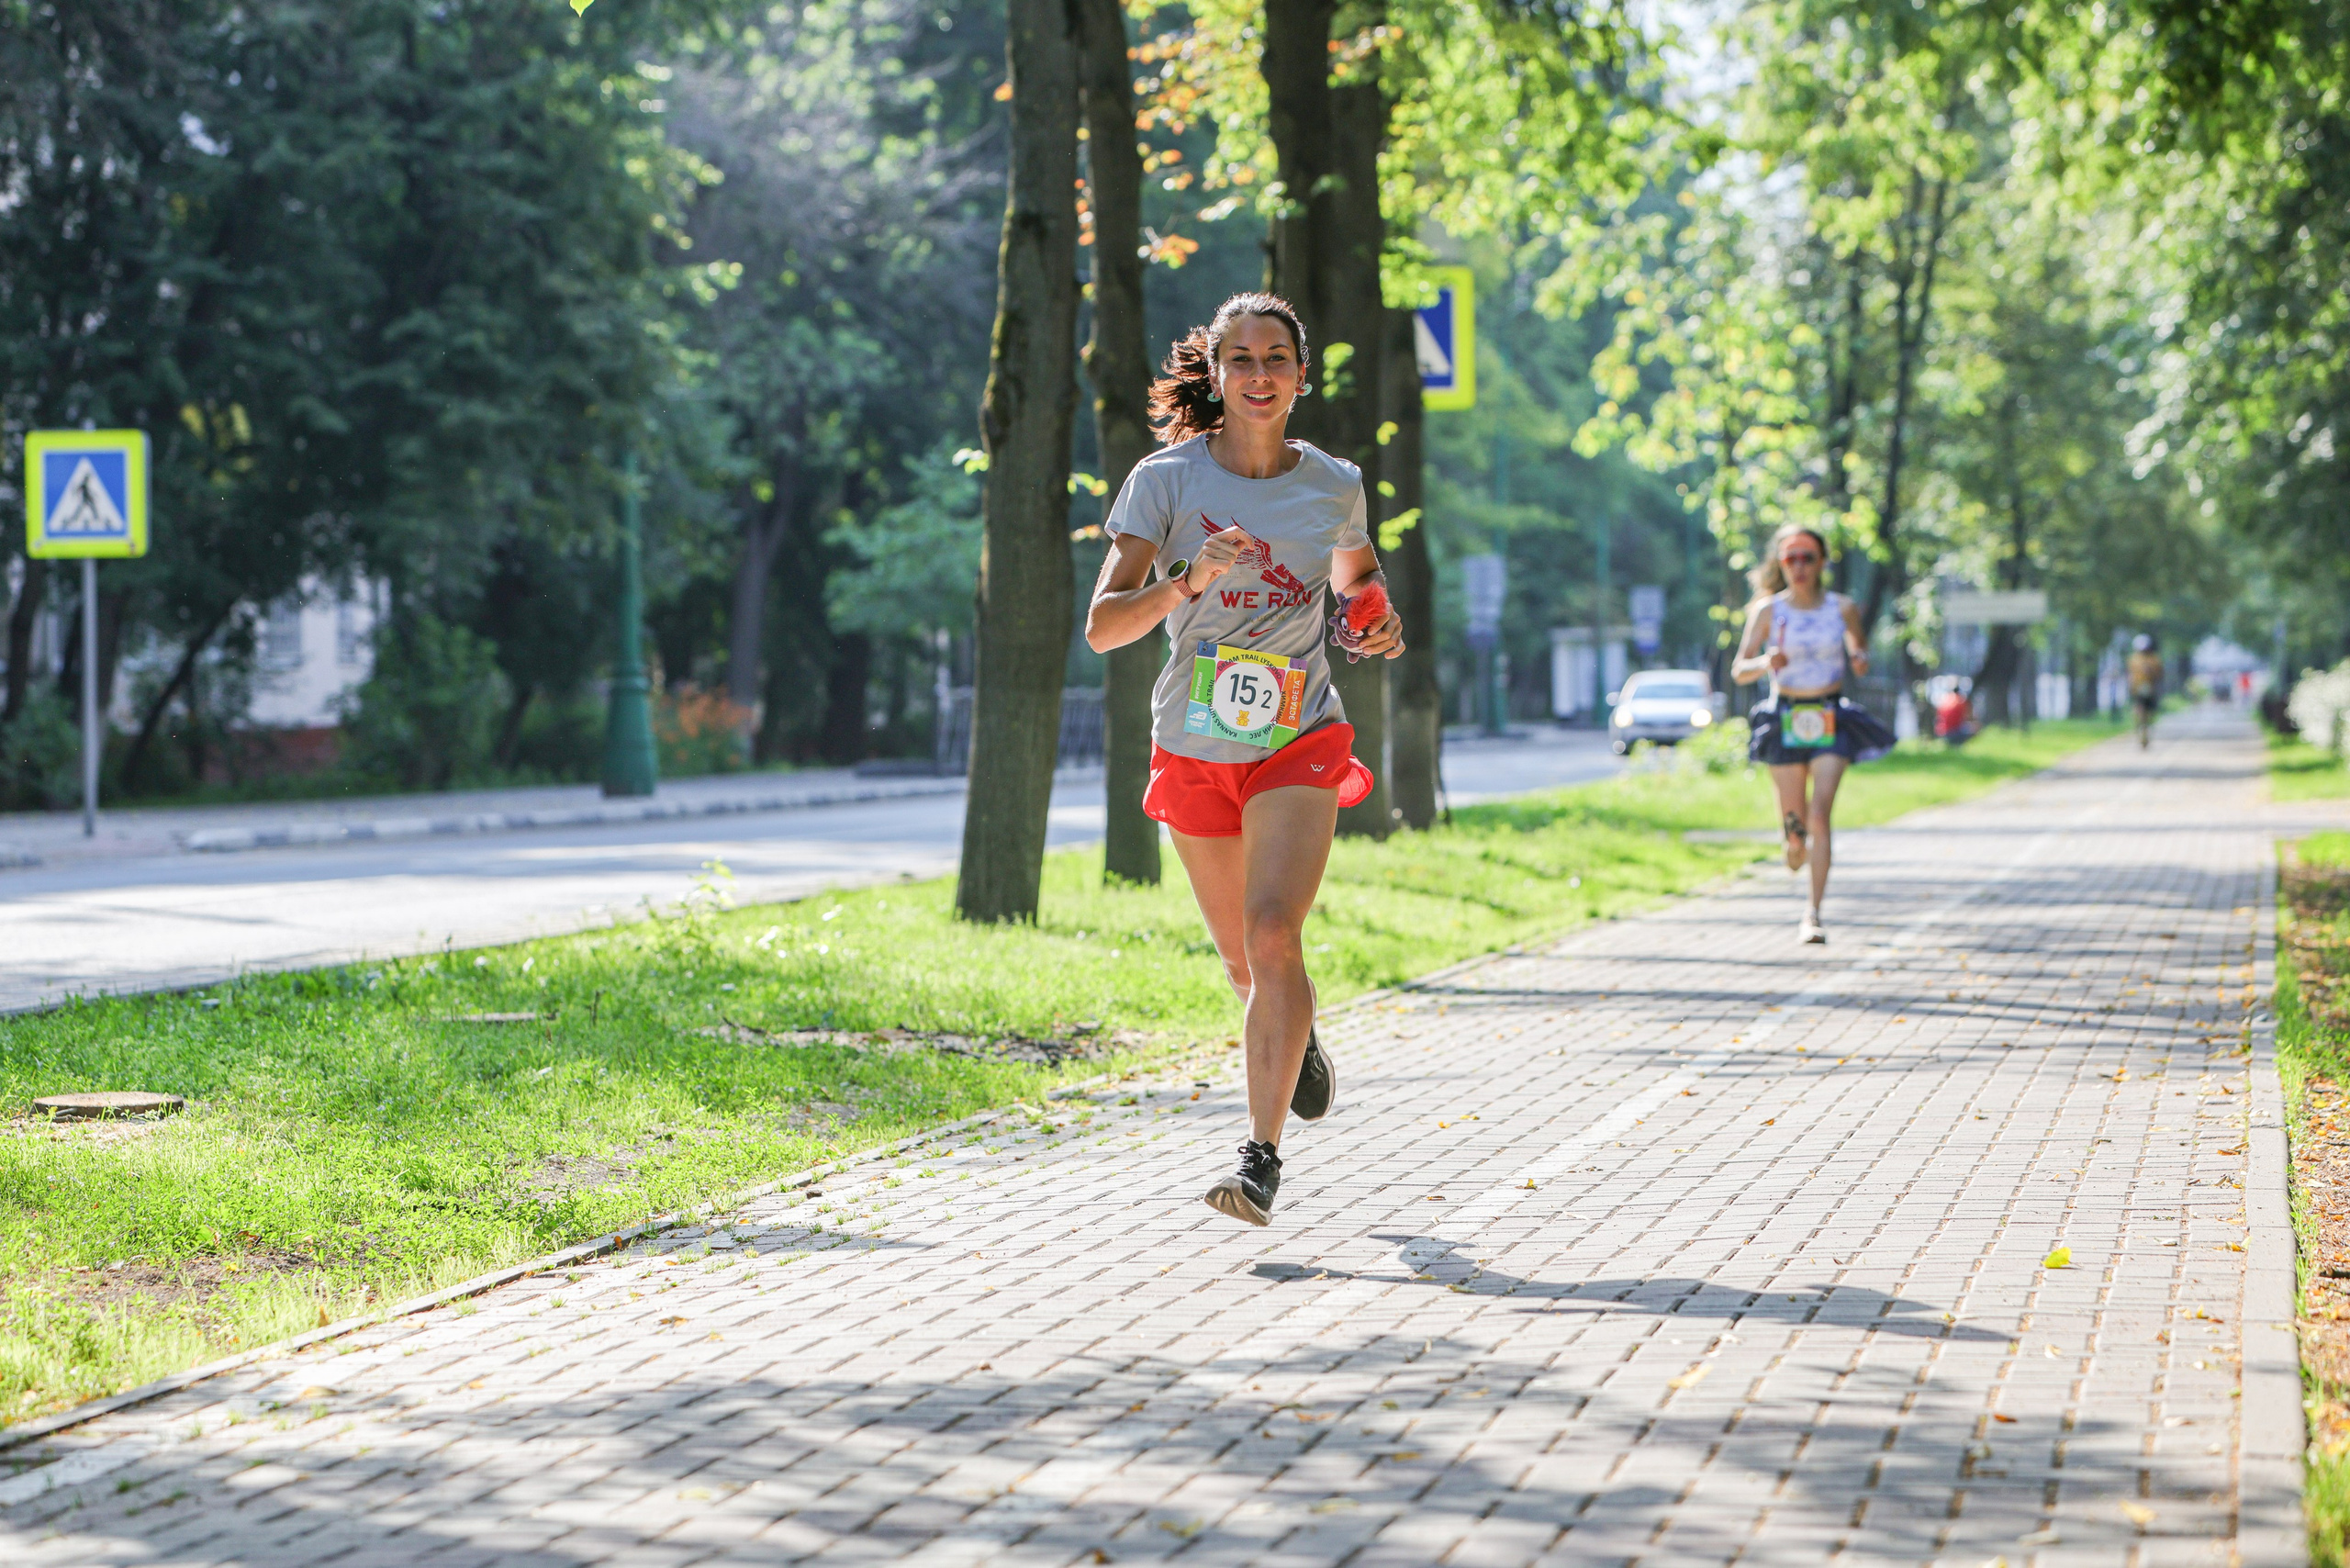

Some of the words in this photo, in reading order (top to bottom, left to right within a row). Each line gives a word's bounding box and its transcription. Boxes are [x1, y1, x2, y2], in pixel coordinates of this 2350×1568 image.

[1220, 590, 1259, 609] WE
[1268, 590, 1313, 609] RUN
[1217, 655, 1239, 672] DREAM
[1240, 654, 1259, 662] TRAIL
[1260, 656, 1282, 679] LYSKOVO
[1206, 679, 1215, 698] TRAIL
[1230, 673, 1259, 706] 15
[1260, 689, 1273, 710] 2
[1288, 679, 1301, 721] ЭСТАФЕТА
[1263, 690, 1287, 735] ХИМКИНСКИЙ
[1214, 718, 1238, 738] KANNAS
[1249, 732, 1262, 740] ЛЕС
